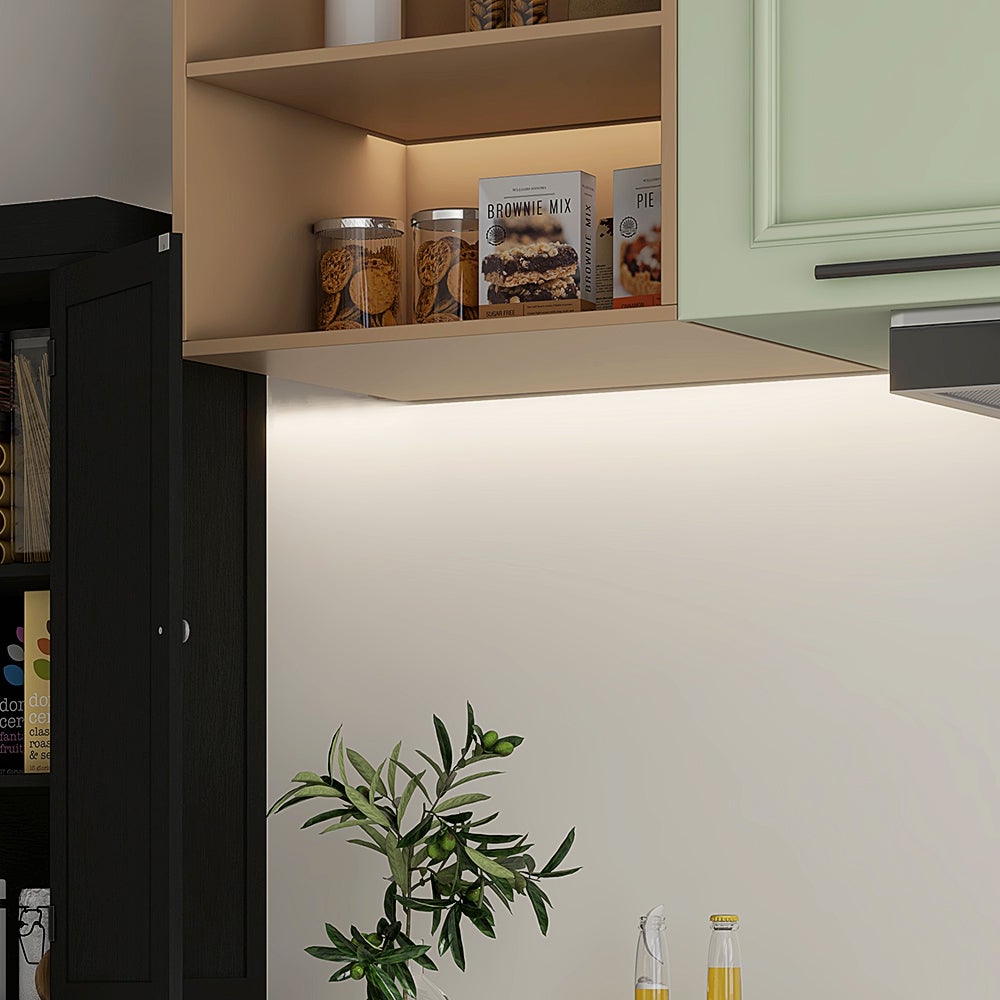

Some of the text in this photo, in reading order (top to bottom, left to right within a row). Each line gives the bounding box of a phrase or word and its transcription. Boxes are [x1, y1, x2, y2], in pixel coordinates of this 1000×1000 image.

[487, 198, 572, 219] BROWNIE MIX
[636, 191, 655, 209] PIE
[584, 204, 592, 293] BROWNIE MIX
[29, 750, 39, 760] &
